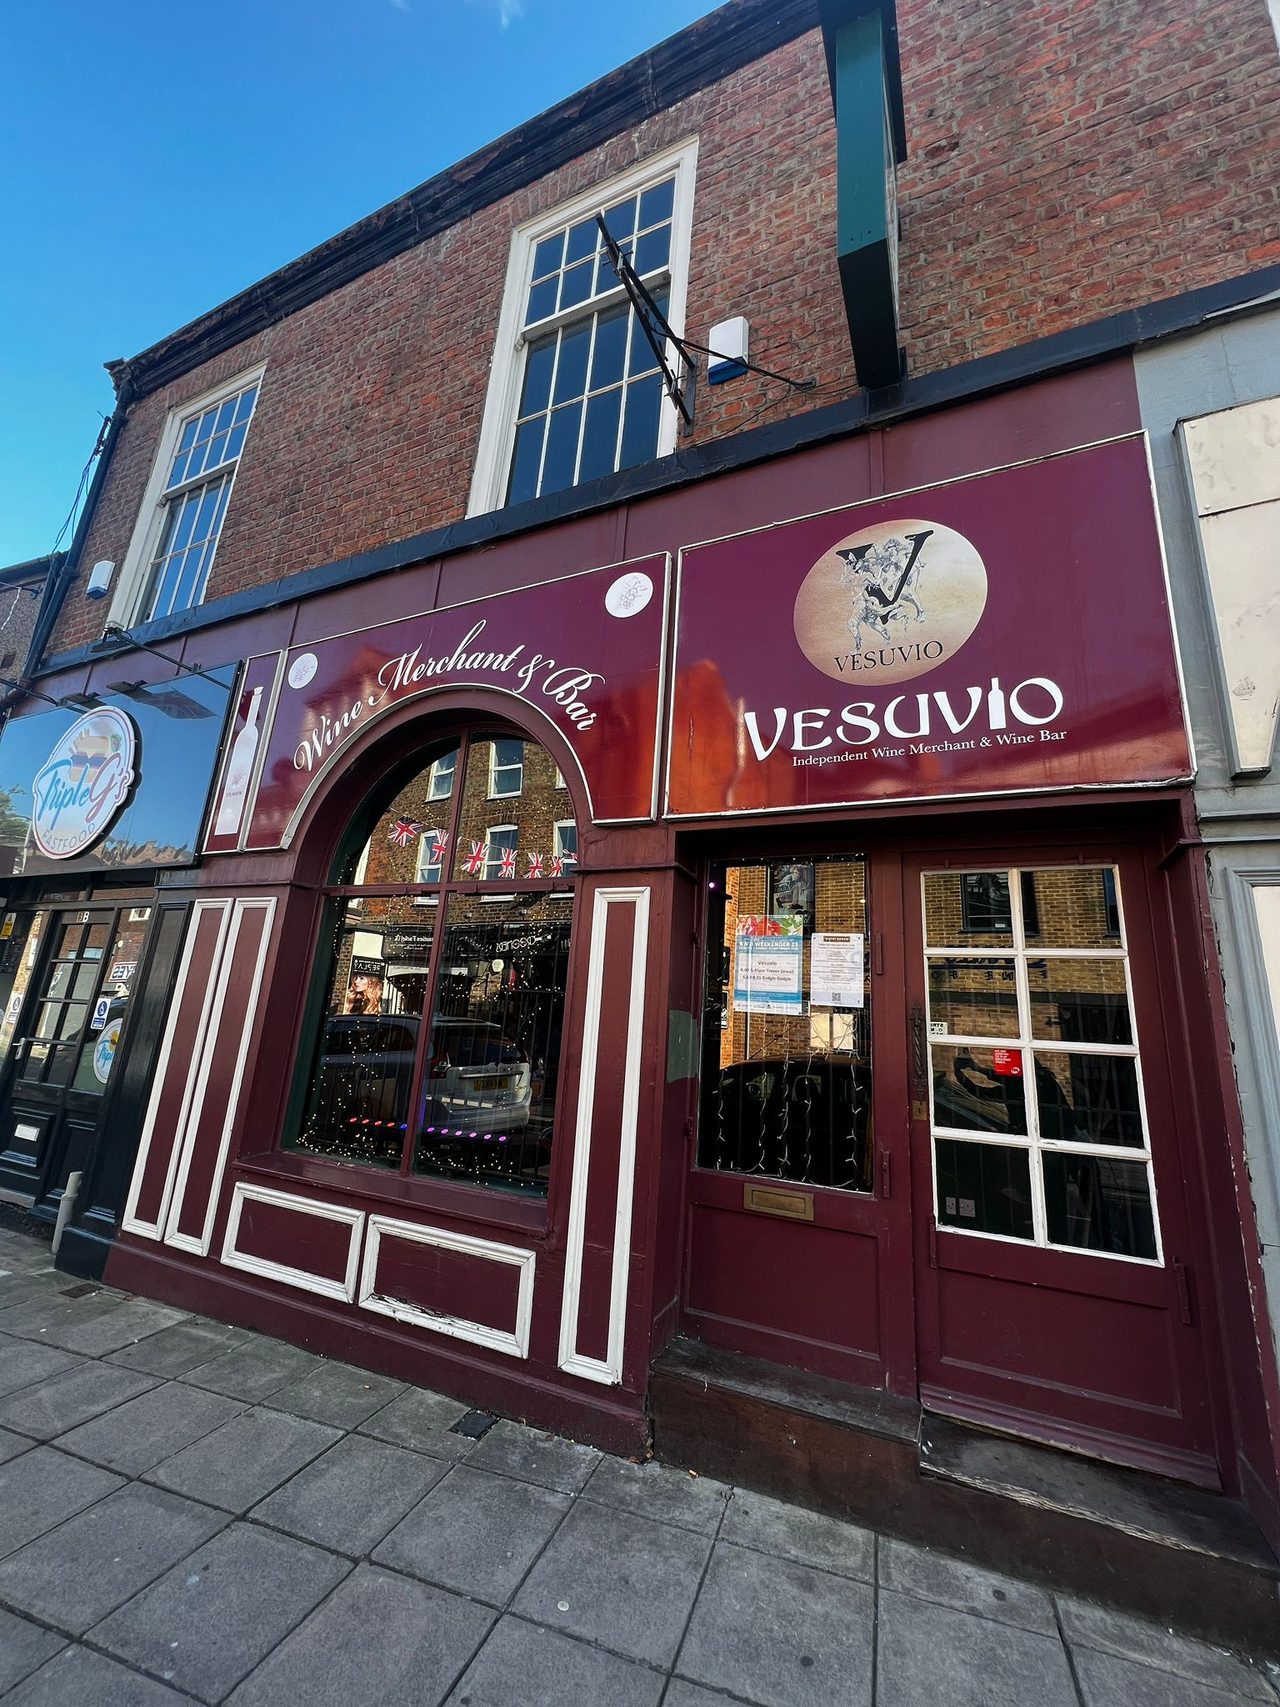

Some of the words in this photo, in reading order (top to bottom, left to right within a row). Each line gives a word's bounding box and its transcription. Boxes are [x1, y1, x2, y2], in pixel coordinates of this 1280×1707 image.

[834, 640, 944, 672] VESUVIO
[293, 703, 362, 772] Wine
[369, 619, 526, 707] Merchant
[512, 654, 555, 694] &
[541, 667, 606, 731] Bar
[743, 677, 1064, 762] VESUVIO
[792, 750, 869, 767] Independent
[871, 746, 906, 758] Wine
[908, 739, 976, 755] Merchant
[979, 736, 993, 748] &
[995, 730, 1036, 746] Wine
[1038, 728, 1068, 743] Bar
[37, 758, 90, 831] Triple
[85, 753, 127, 823] G's
[41, 821, 96, 850] FASTFOOD
